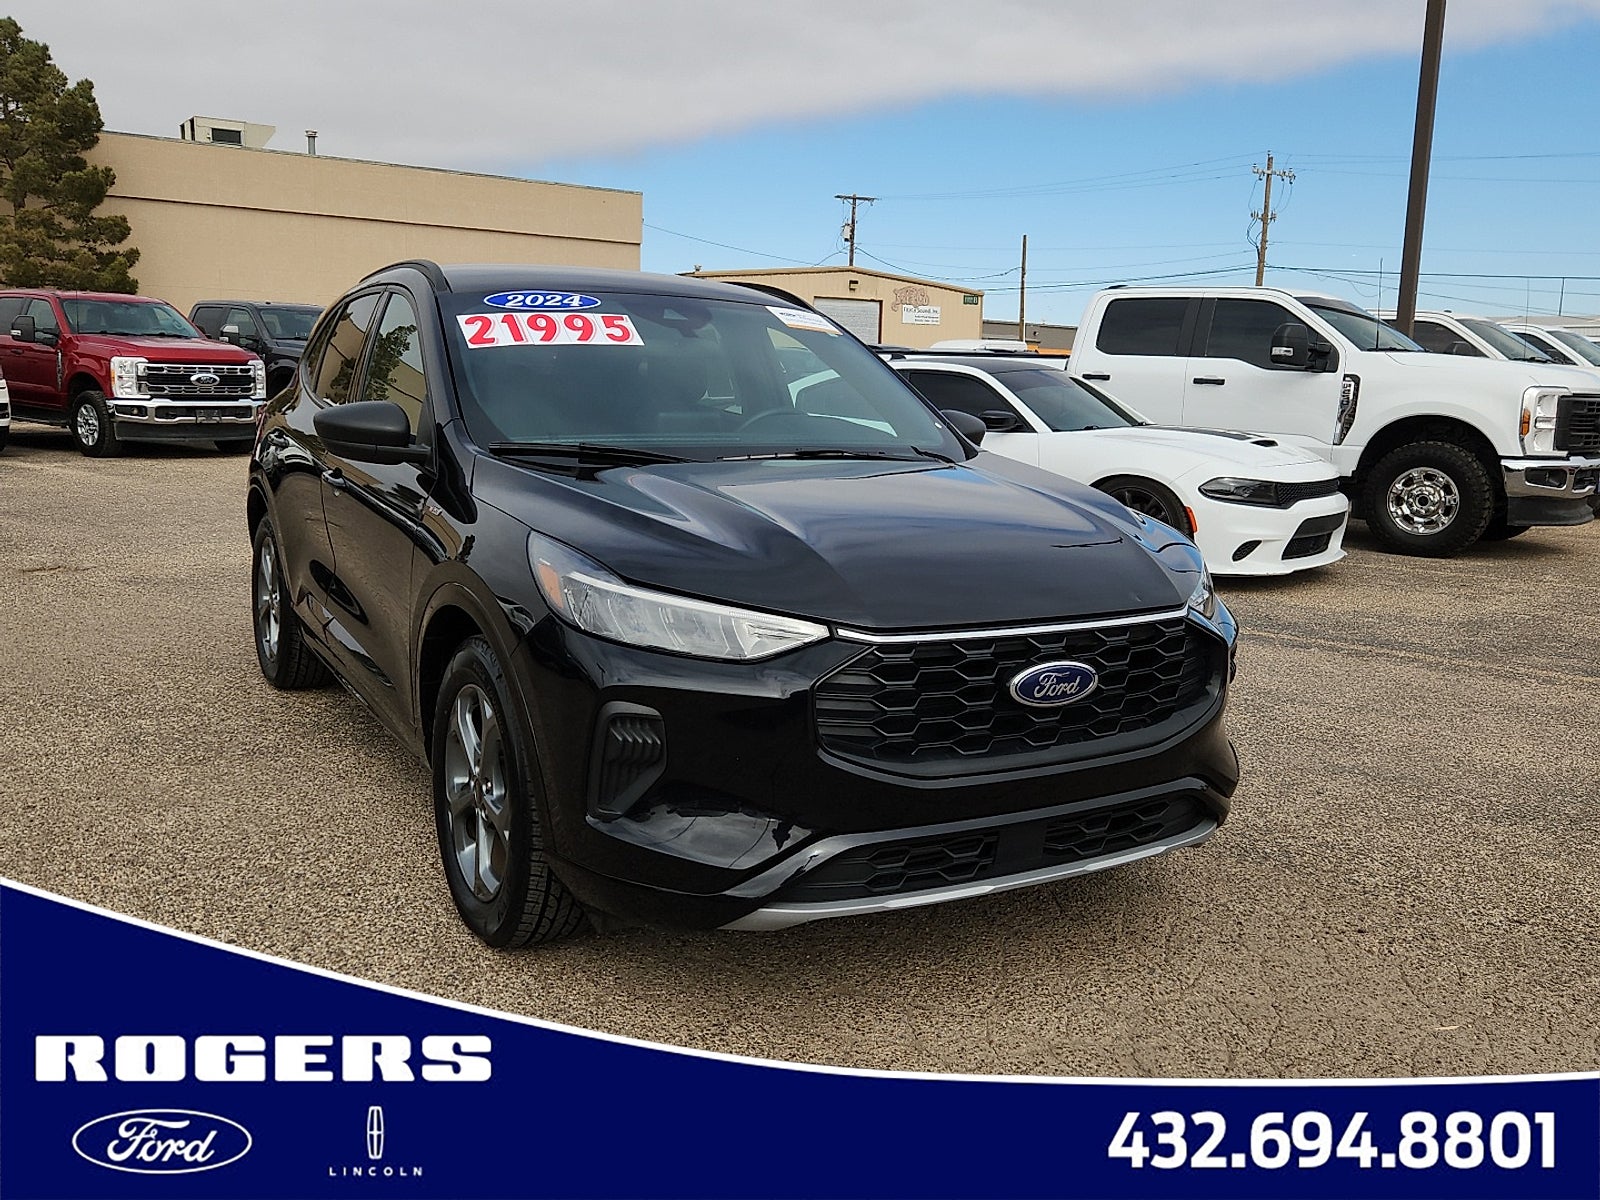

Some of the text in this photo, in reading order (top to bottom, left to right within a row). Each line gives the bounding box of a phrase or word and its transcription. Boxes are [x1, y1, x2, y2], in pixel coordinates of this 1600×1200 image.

[505, 294, 584, 307] 2024
[464, 313, 632, 345] 21995
[1034, 671, 1082, 698] Ford
